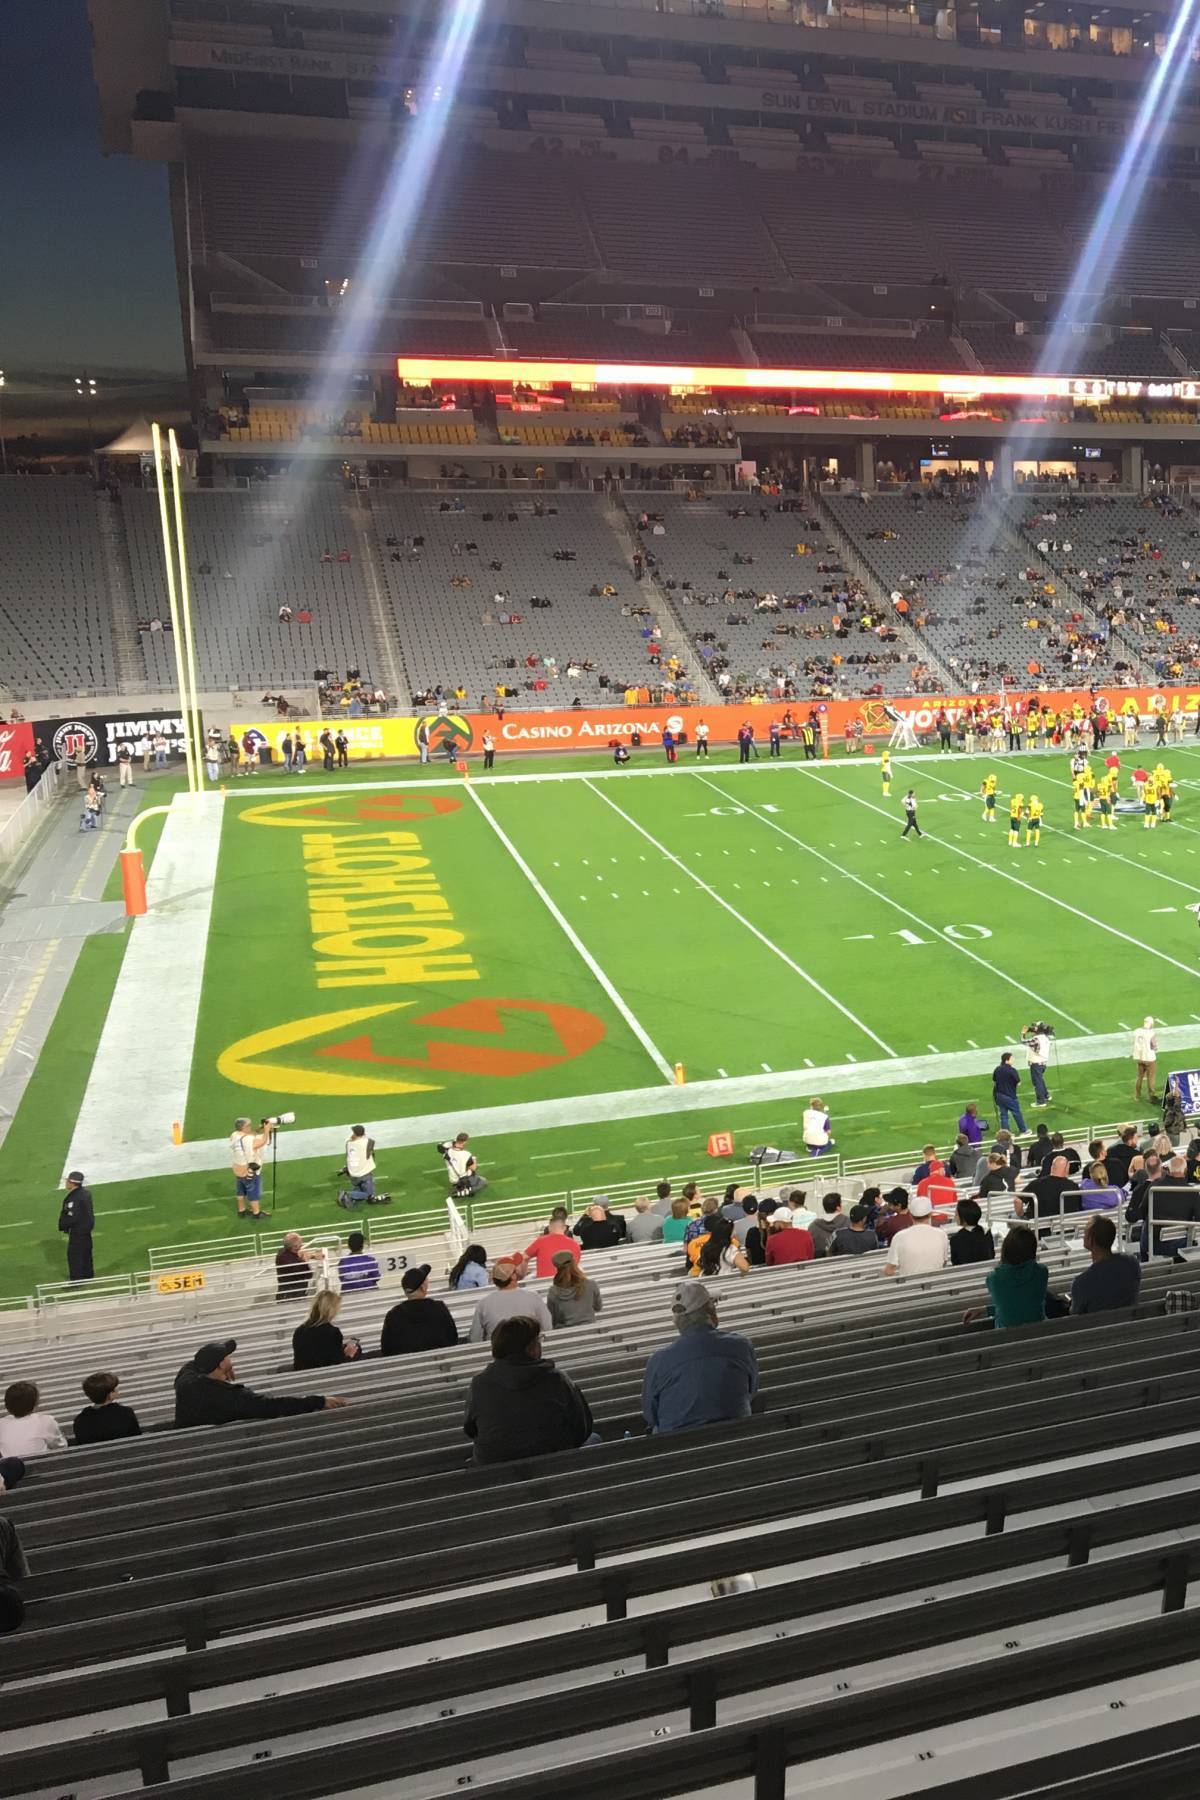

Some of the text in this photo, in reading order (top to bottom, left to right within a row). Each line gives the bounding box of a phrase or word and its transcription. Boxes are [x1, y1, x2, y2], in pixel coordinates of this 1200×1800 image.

[761, 92, 938, 121] SUN DEVIL STADIUM
[981, 111, 1041, 129] FRANK
[1045, 115, 1091, 132] KUSH
[502, 721, 661, 739] CASINO ARIZONA
[301, 831, 481, 989] HOTSHOTS
[889, 923, 994, 946] 10
[714, 1134, 730, 1154] G
[387, 1255, 408, 1271] 33
[1110, 1700, 1126, 1709] 10
[654, 1727, 667, 1736] 12
[457, 1775, 472, 1785] 13
